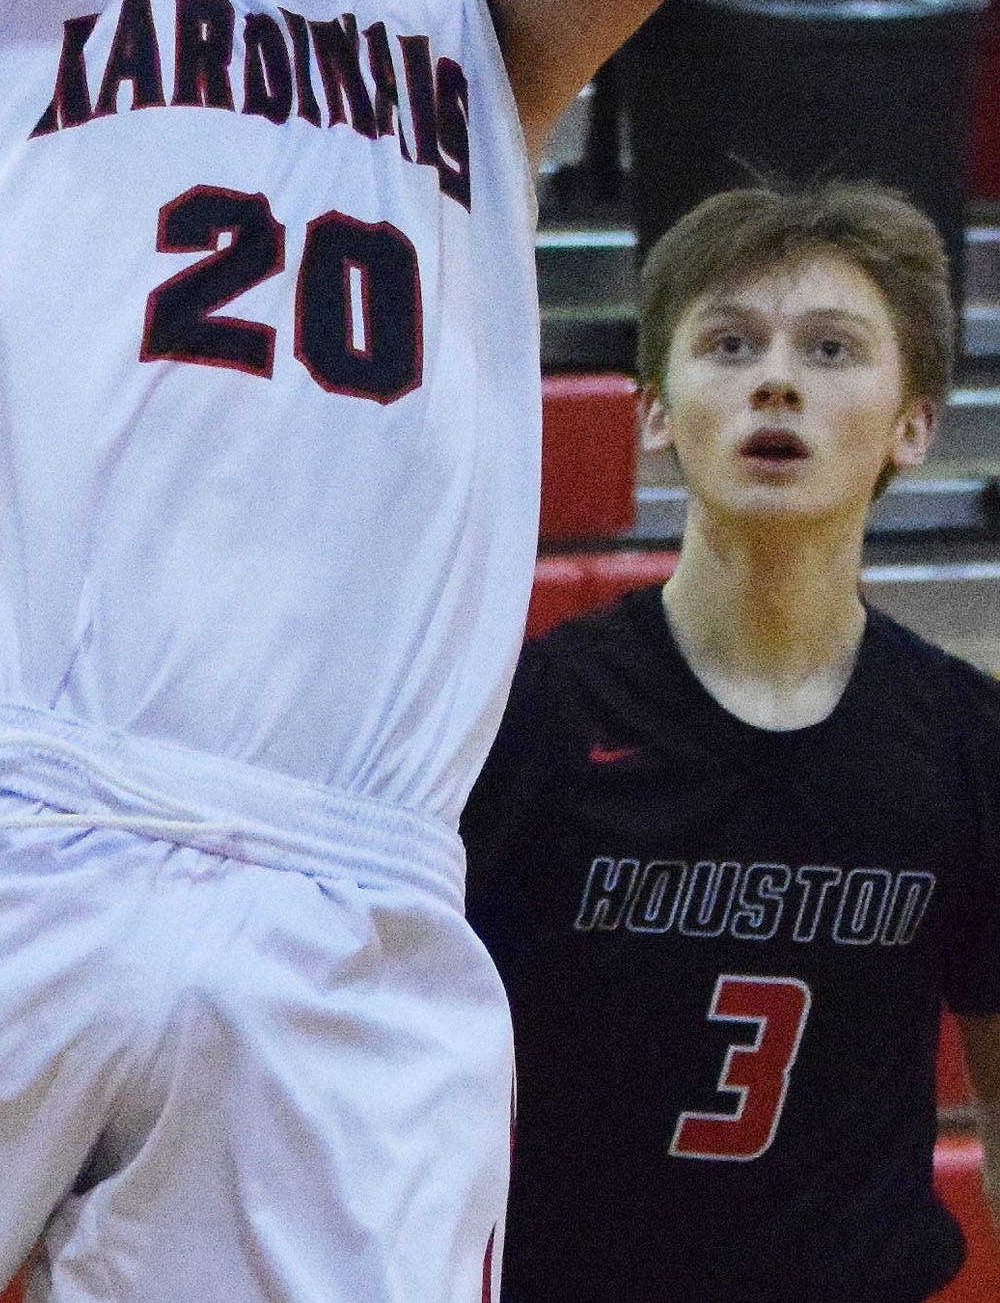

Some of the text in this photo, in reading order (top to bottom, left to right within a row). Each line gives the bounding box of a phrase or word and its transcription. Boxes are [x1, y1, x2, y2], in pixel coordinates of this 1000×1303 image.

[139, 183, 424, 405] 20
[574, 857, 936, 946] HOUSTON
[669, 975, 812, 1161] 3
